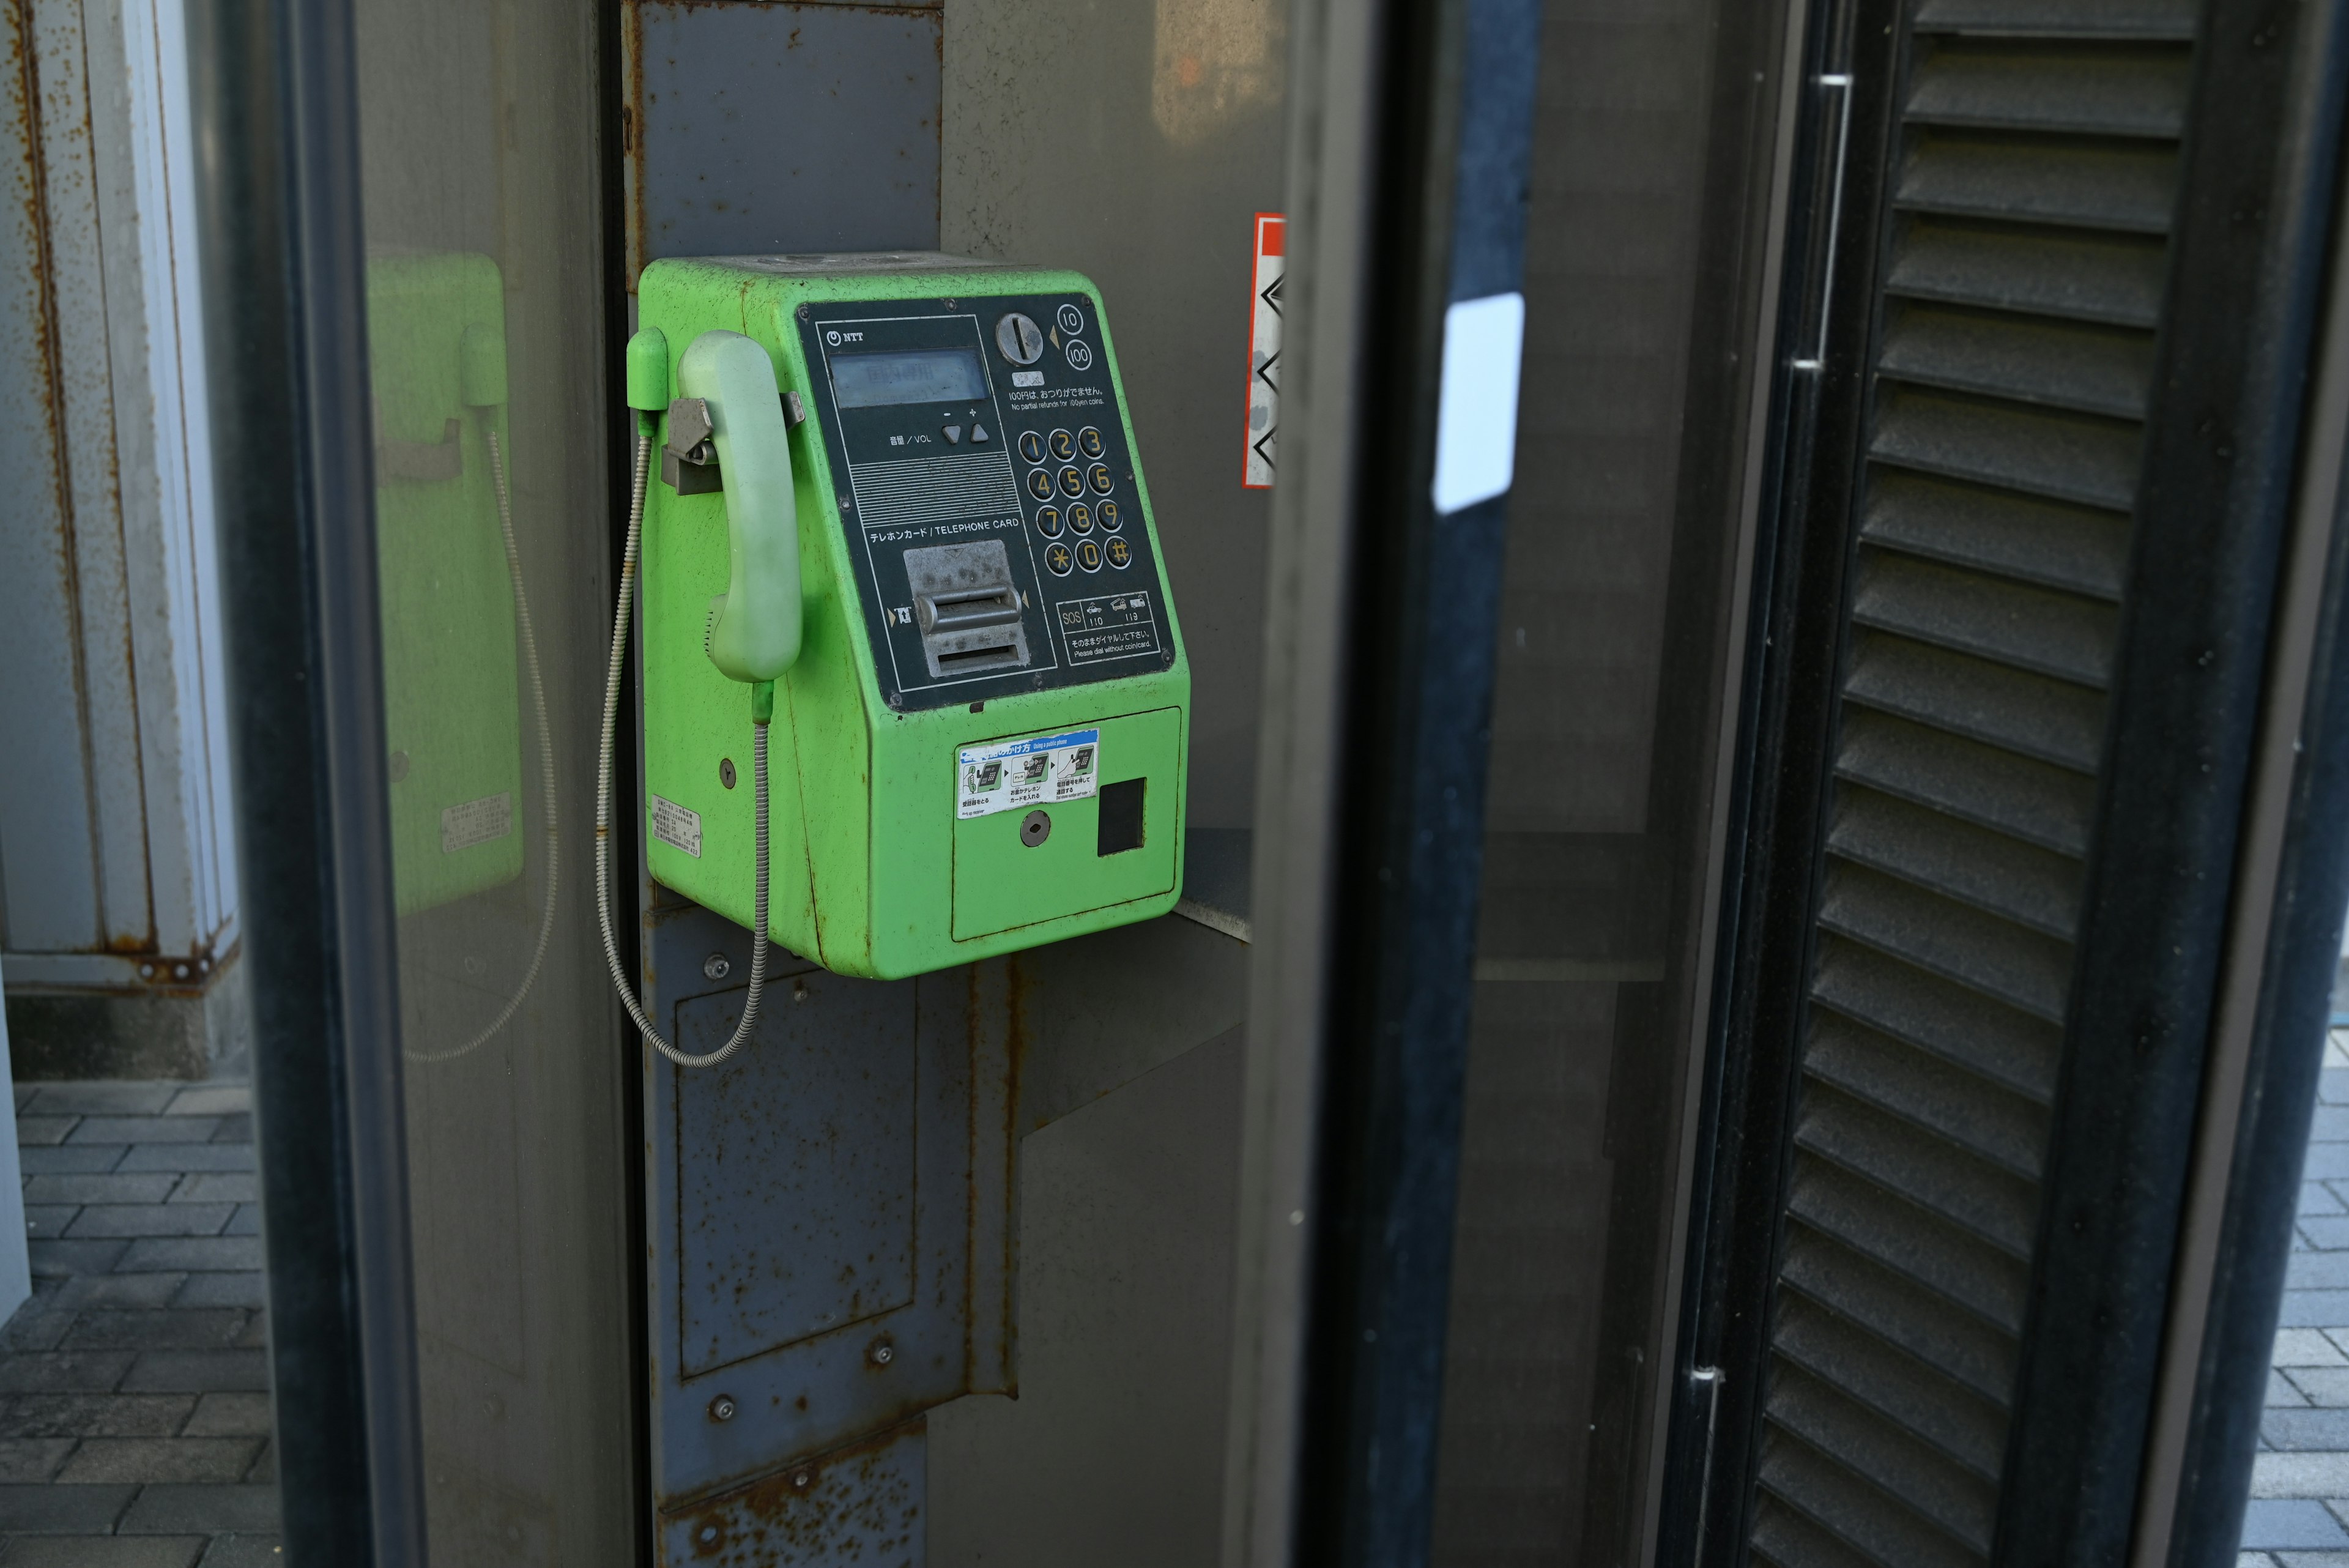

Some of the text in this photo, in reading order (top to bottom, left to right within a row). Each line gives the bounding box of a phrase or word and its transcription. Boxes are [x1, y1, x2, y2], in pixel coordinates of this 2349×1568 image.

[1063, 312, 1077, 327] 10
[843, 332, 863, 342] NTT
[1070, 348, 1088, 363] 100
[889, 435, 905, 445] 音量
[1032, 431, 1100, 456] 1 2 3
[1038, 468, 1110, 494] 4 5 6
[1047, 504, 1117, 531] 7 8 9
[870, 527, 927, 543] テレホンカード
[935, 521, 990, 535] TELEPHONE
[993, 518, 1019, 529] CARD
[1084, 544, 1099, 565] 0
[1063, 611, 1138, 626] SOS 110 119
[1072, 630, 1149, 648] そのままダイヤルして下さい。
[1104, 644, 1124, 653] without
[1057, 778, 1090, 787] 電話番号を押して
[1011, 786, 1040, 795] お金かテレホン
[962, 798, 989, 808] 受話器をとる
[1011, 794, 1039, 803] カードを入れる
